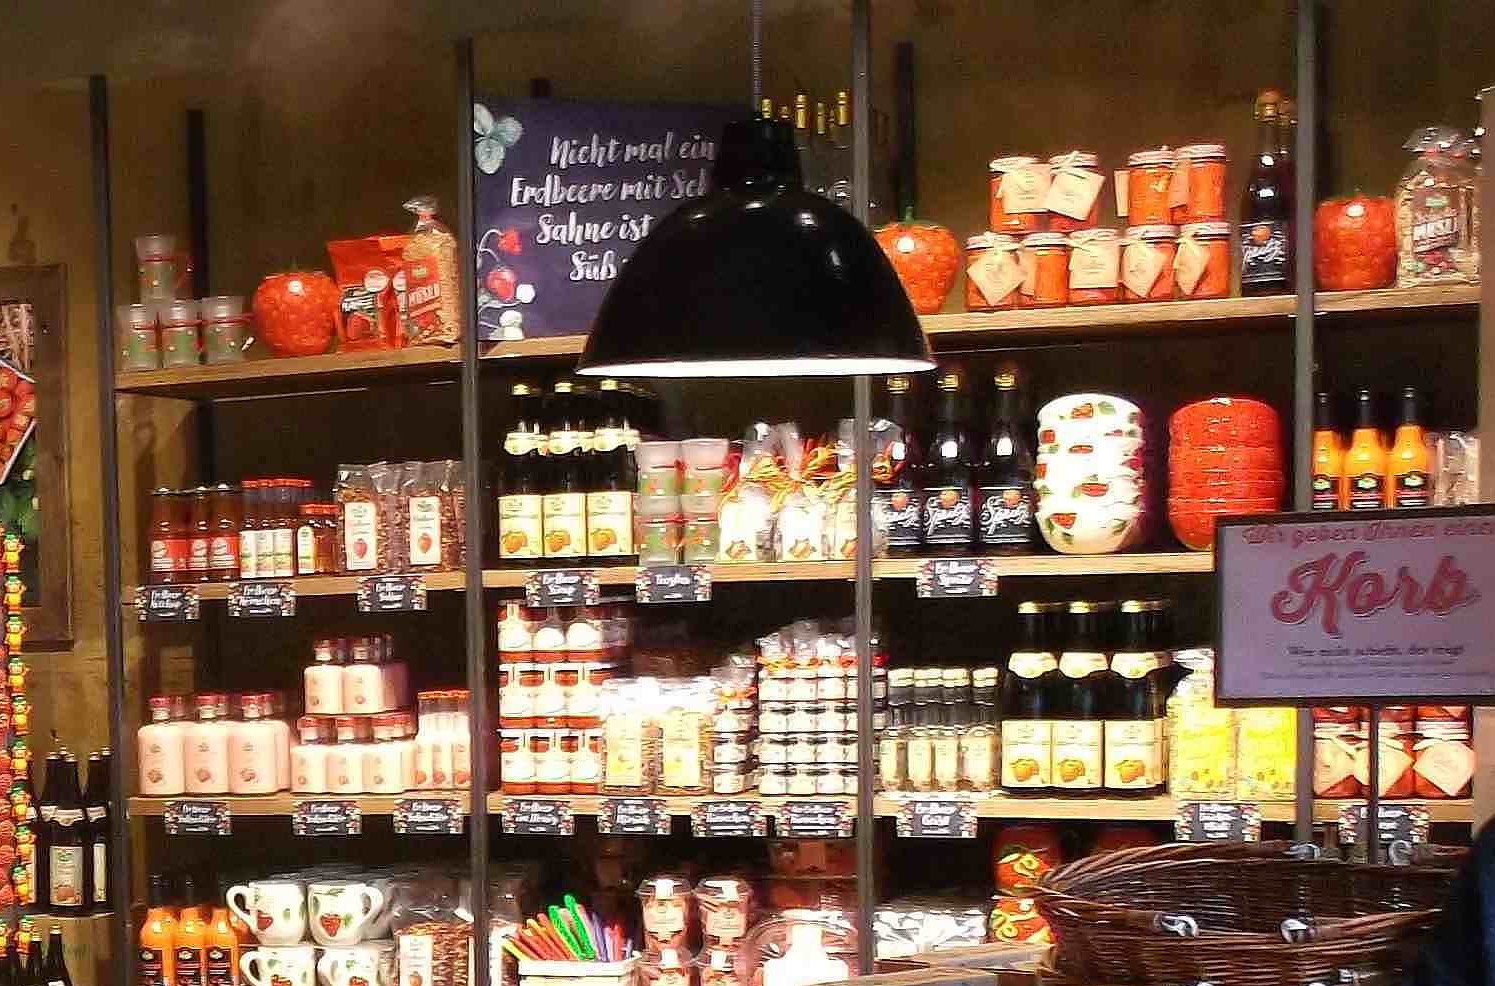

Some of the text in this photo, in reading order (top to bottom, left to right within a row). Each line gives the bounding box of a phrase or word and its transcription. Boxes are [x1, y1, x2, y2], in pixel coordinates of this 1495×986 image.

[550, 132, 715, 168] Nicht mal ein
[510, 174, 619, 207] Erdbeere
[621, 174, 666, 201] mit
[536, 211, 654, 246] Sahne ist
[1271, 550, 1482, 639] Korb
